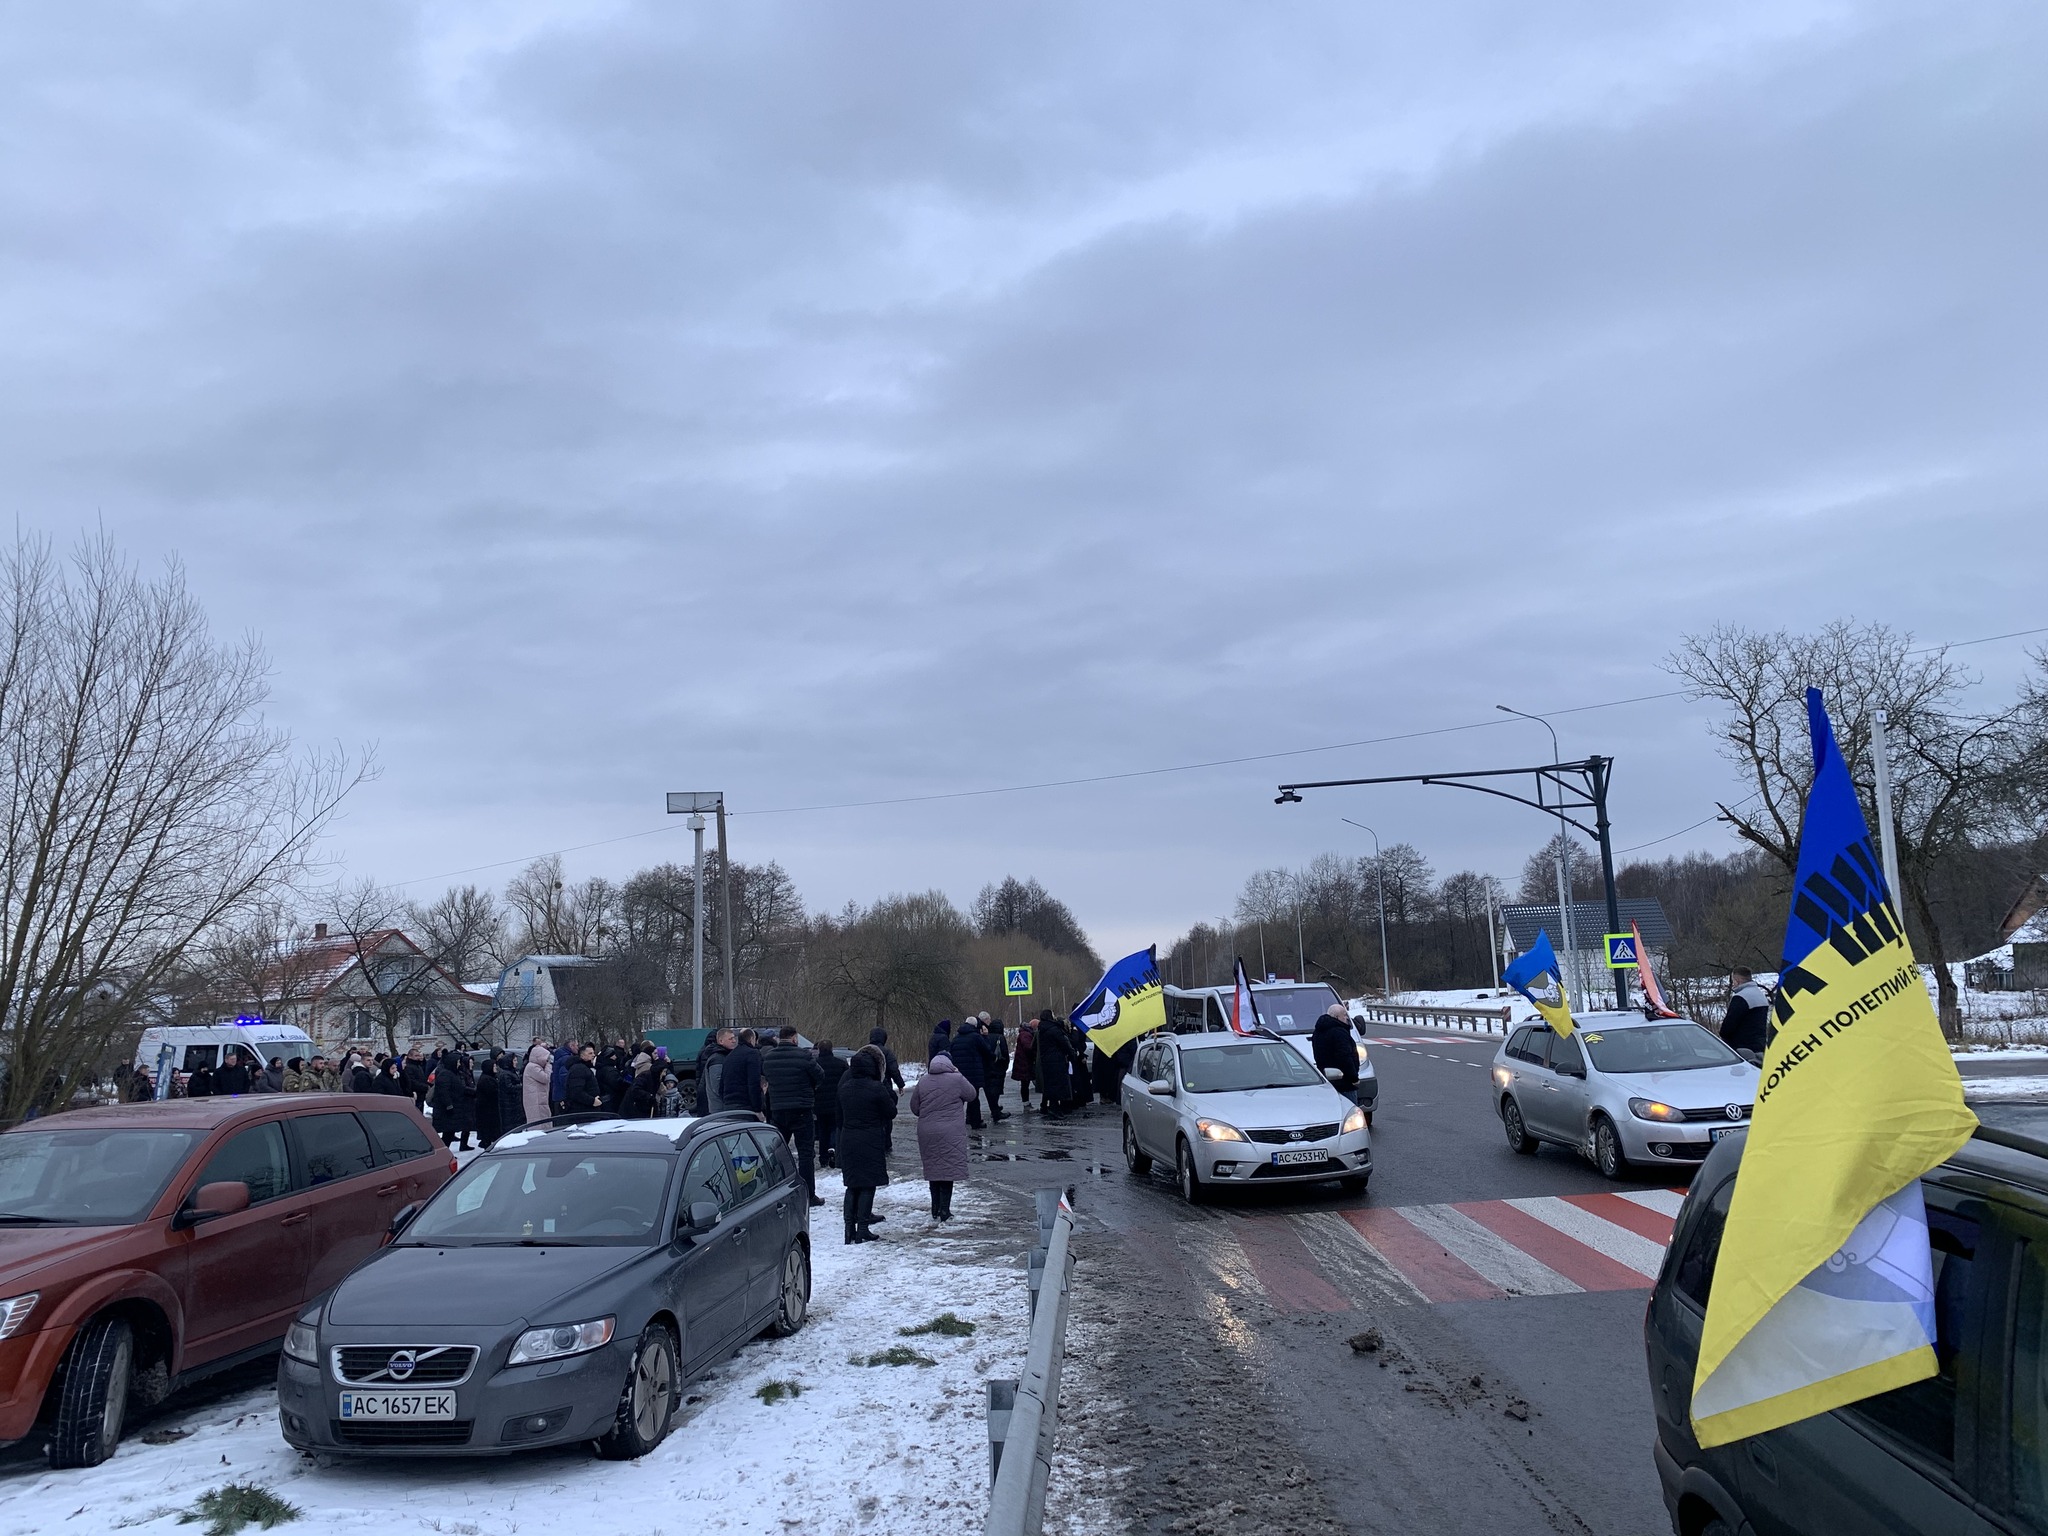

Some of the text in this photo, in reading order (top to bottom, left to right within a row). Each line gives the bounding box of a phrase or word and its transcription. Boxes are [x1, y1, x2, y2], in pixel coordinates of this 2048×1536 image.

[1759, 1033, 1823, 1103] КОЖЕН
[1819, 966, 1912, 1040] ПОЛЕГЛИЙ
[1278, 1150, 1326, 1164] AC 4253 HX
[353, 1396, 451, 1415] AC 1657 EK
